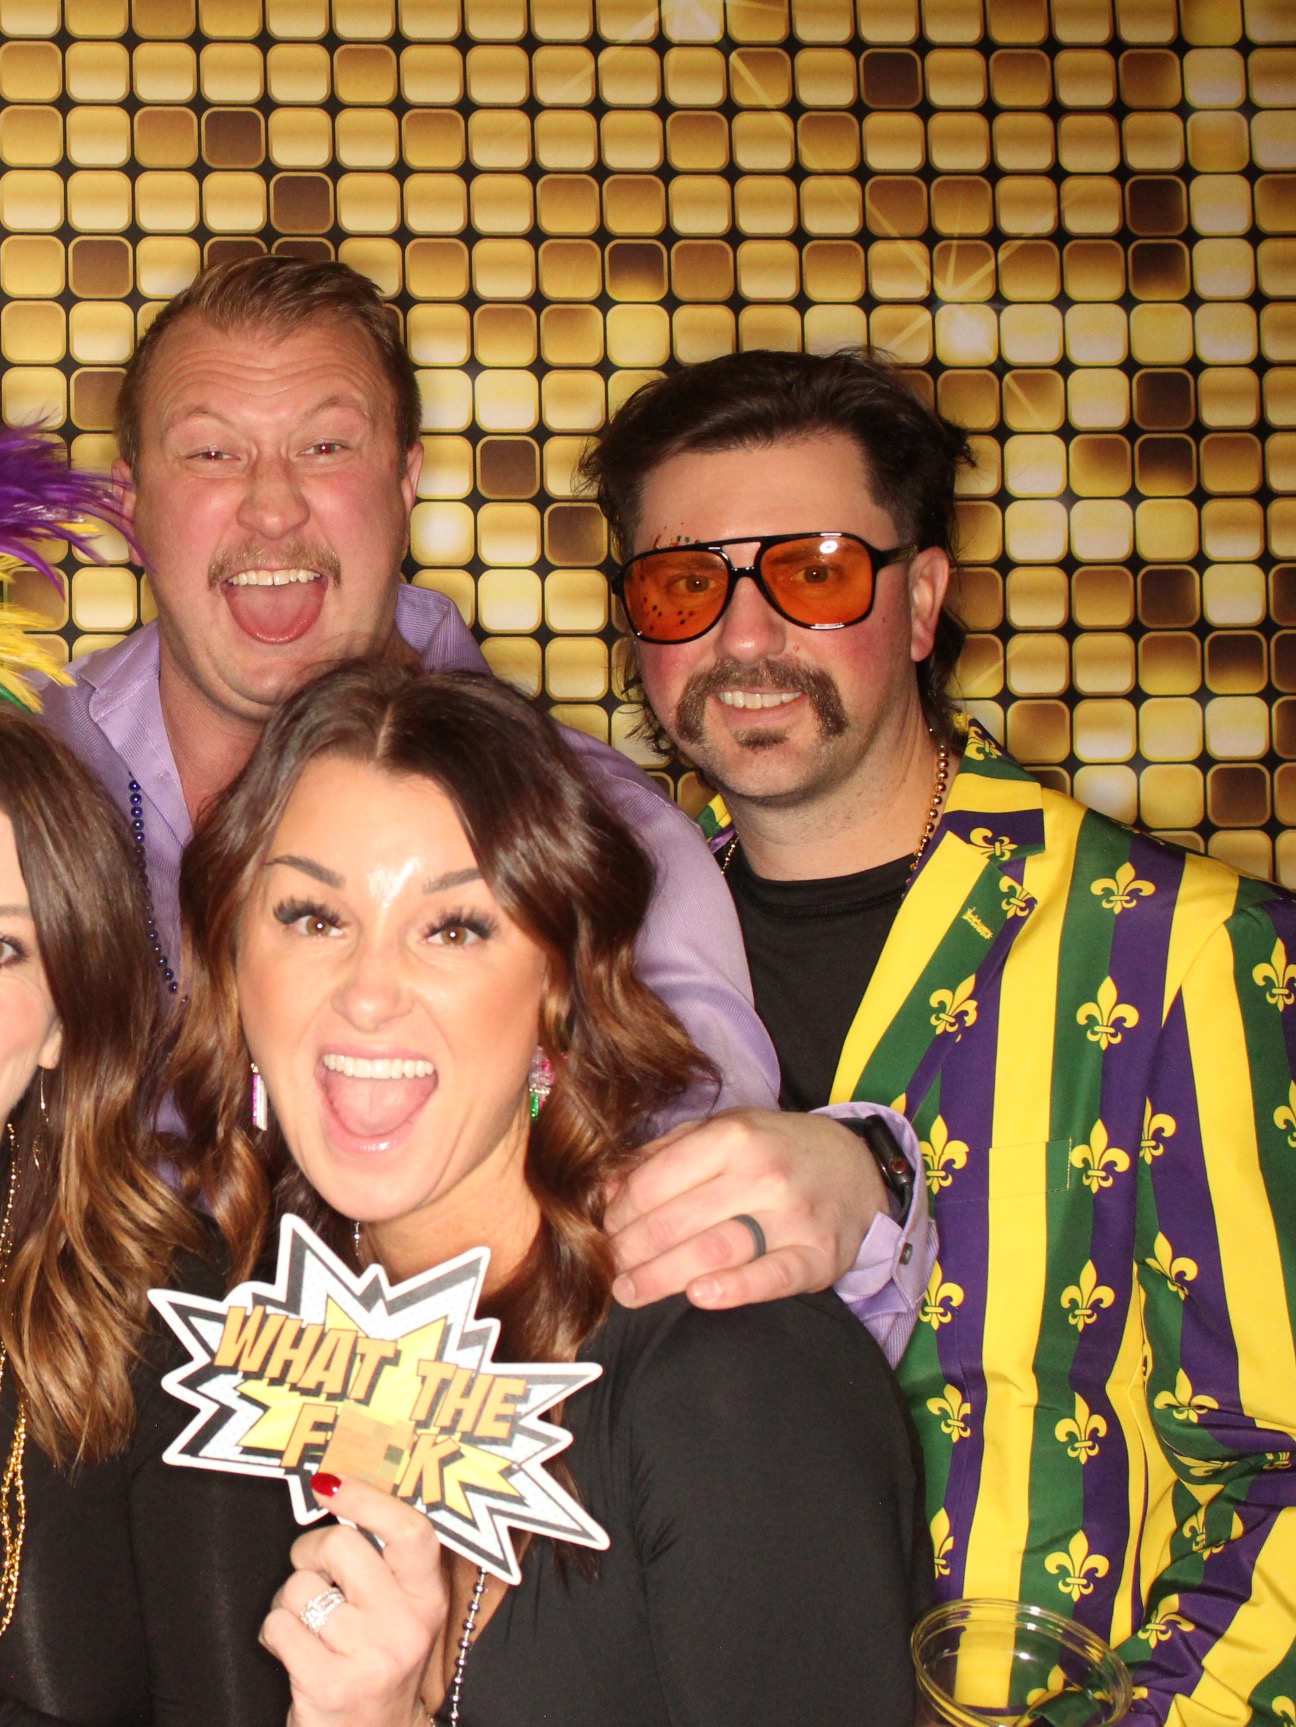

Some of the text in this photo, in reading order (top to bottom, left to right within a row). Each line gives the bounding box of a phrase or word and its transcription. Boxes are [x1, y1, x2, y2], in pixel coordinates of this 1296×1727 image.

[213, 1305, 530, 1443] WHAT THE
[280, 1402, 461, 1505] FK
